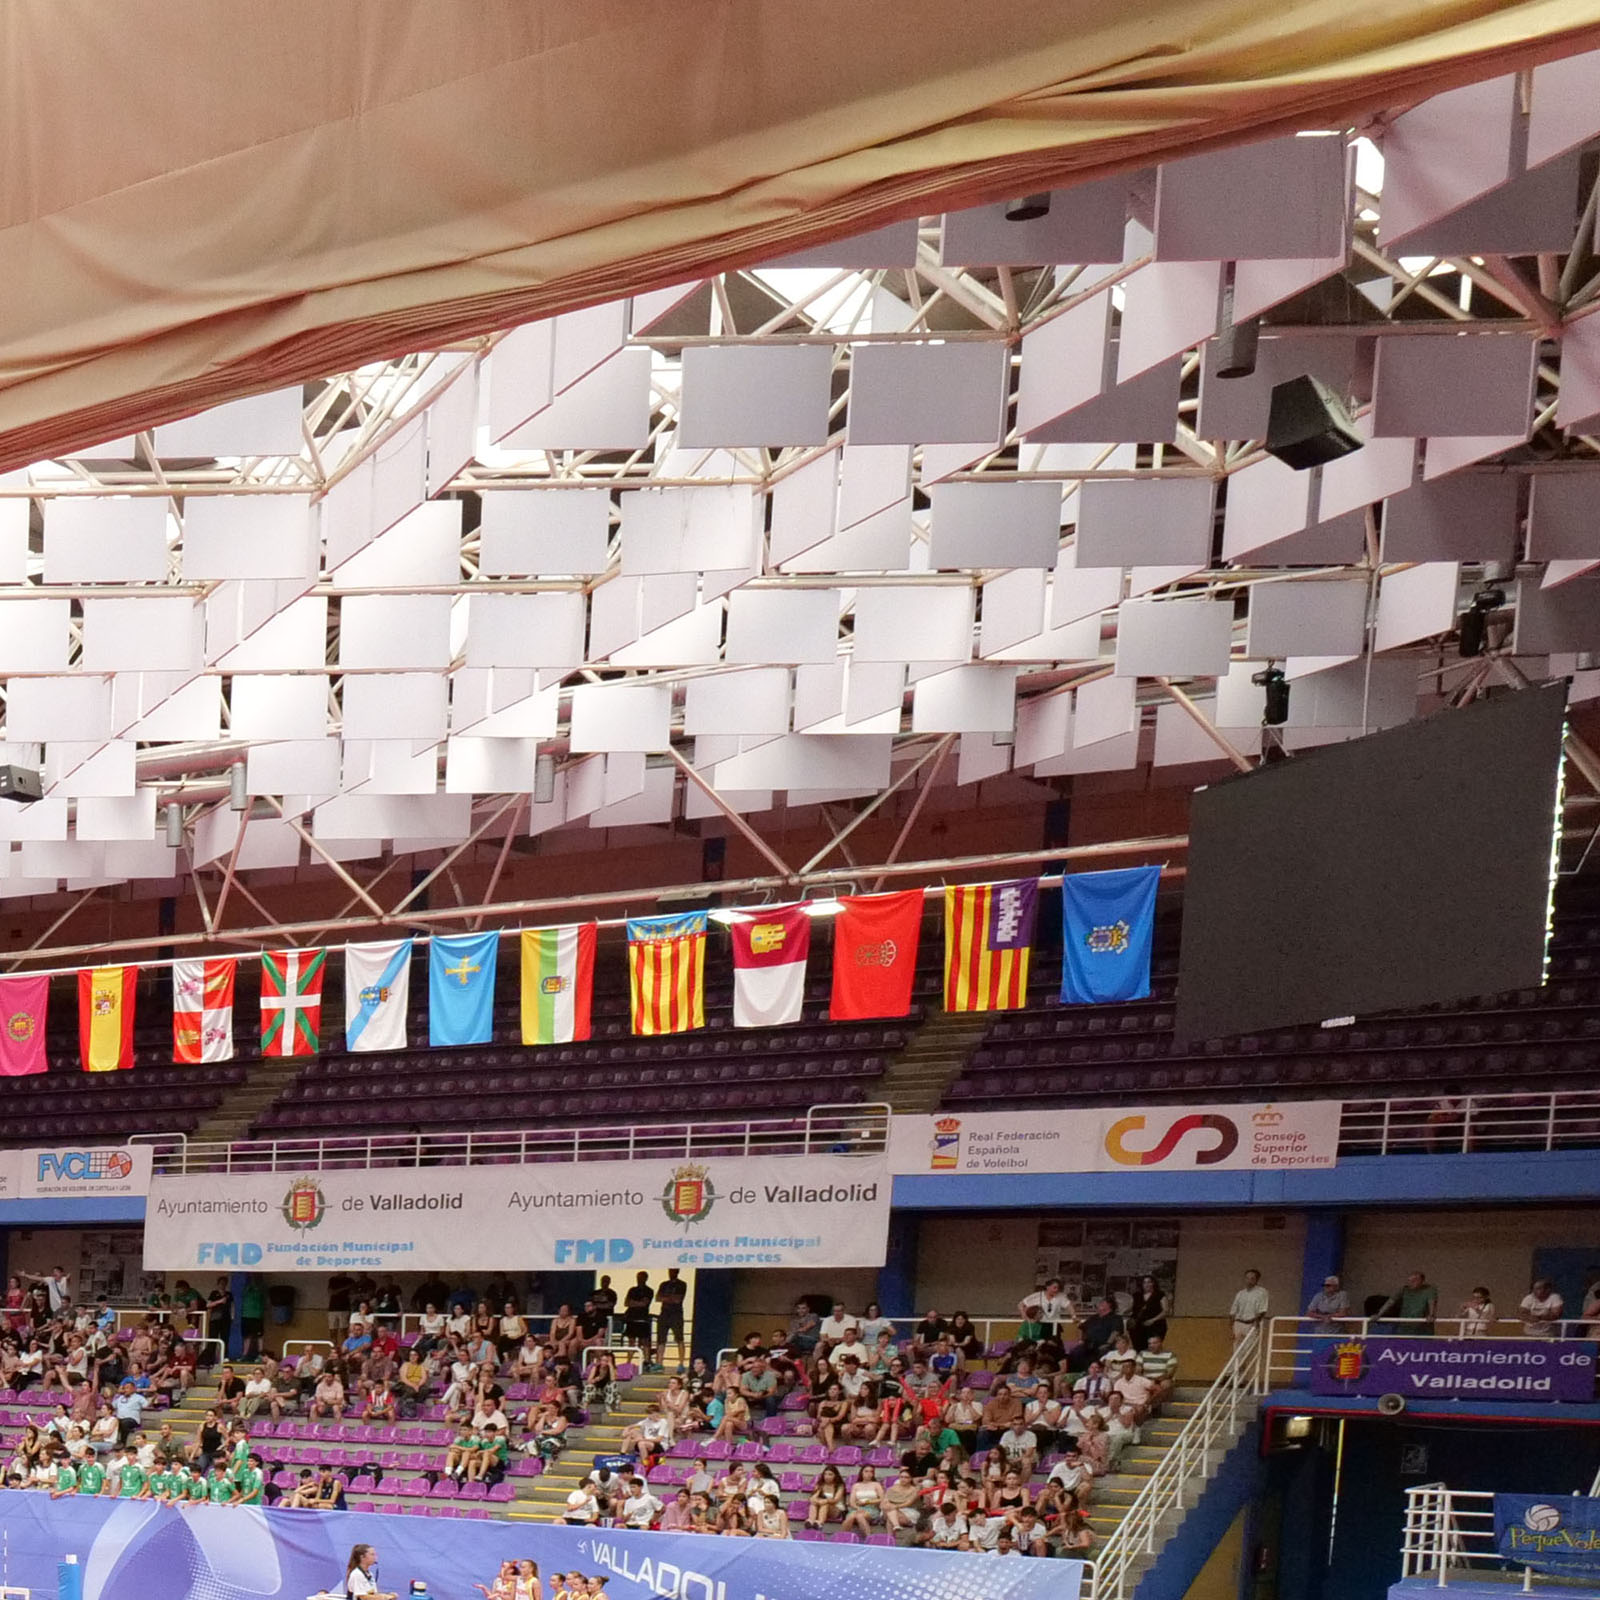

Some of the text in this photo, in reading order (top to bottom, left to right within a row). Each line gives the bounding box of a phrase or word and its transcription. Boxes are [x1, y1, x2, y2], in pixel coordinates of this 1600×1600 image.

[969, 1131, 1060, 1141] Real Federación
[1254, 1131, 1305, 1142] Consejo
[968, 1146, 1020, 1155] Española
[1253, 1143, 1308, 1153] Superior
[966, 1159, 1028, 1168] de Voleibol
[1252, 1154, 1330, 1165] de Deportes
[37, 1152, 102, 1182] FVCL
[508, 1183, 878, 1212] Ayuntamiento de Valladolid
[157, 1193, 463, 1218] Ayuntamiento de Valladolid
[197, 1241, 414, 1265] FMD Fundación Municipal
[555, 1236, 821, 1264] FMD Fundación Municipal
[296, 1255, 382, 1266] de Deportes
[677, 1251, 782, 1265] de Deportes
[1378, 1348, 1591, 1366] Ayuntamiento de
[1411, 1374, 1551, 1391] Valladolid
